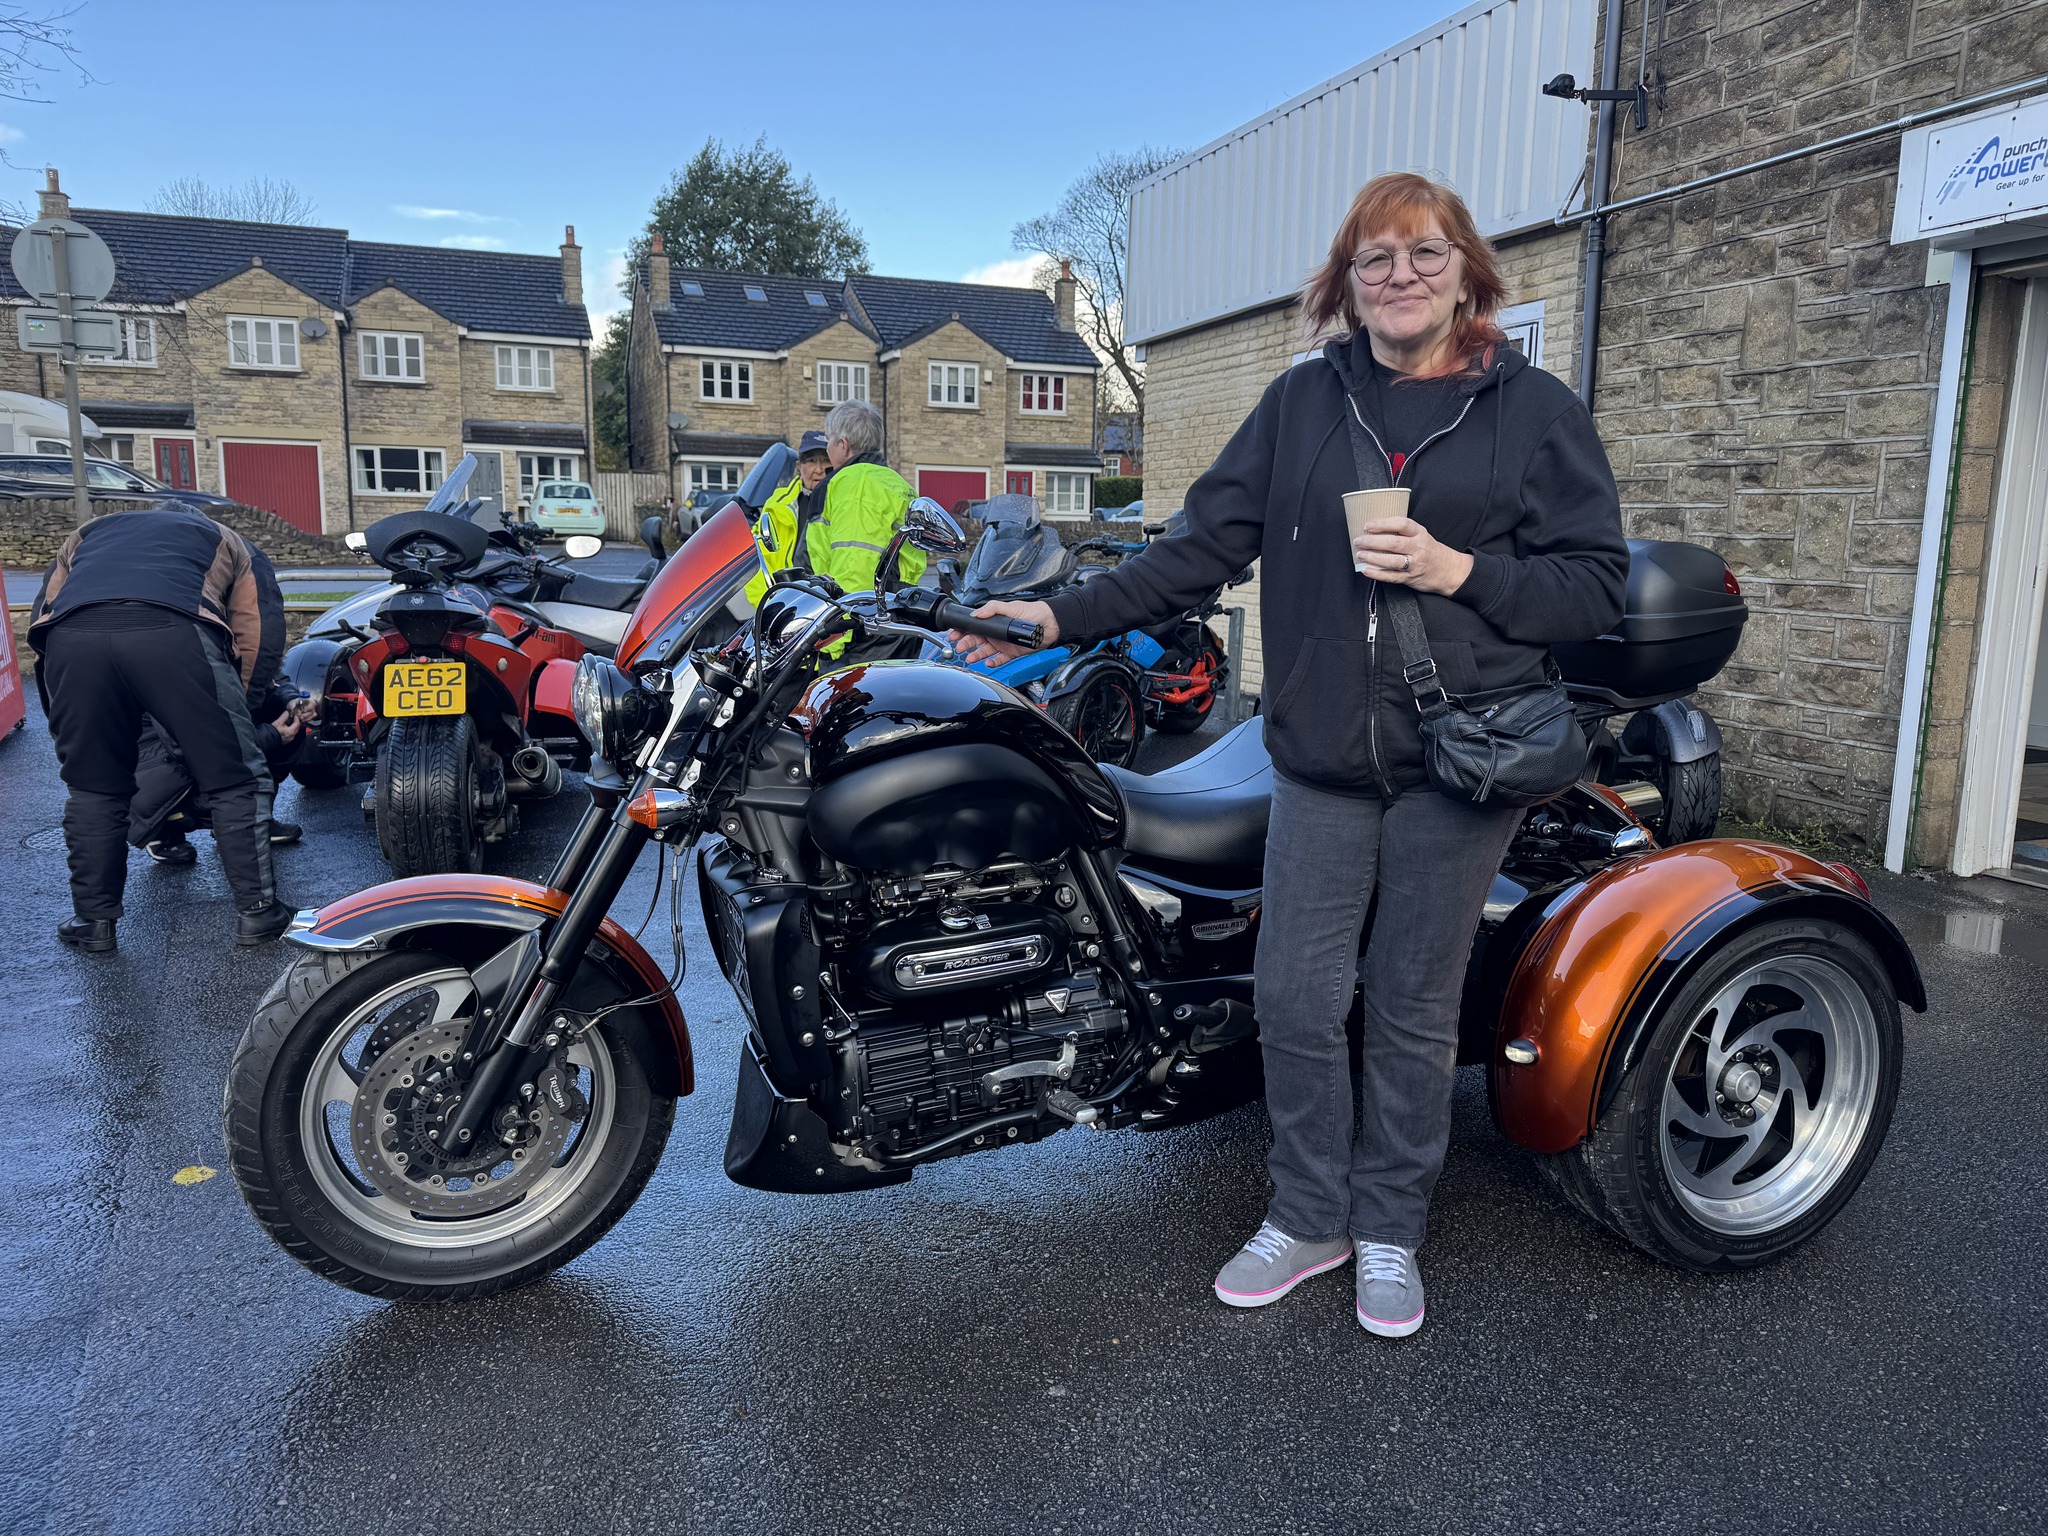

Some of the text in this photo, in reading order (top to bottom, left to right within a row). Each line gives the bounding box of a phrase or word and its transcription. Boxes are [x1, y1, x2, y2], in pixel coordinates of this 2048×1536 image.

[1899, 119, 1911, 127] GAS
[2002, 137, 2048, 161] punch
[1996, 174, 2046, 191] Gear up for
[389, 667, 463, 689] AE62
[397, 689, 453, 710] CEO
[1195, 923, 1230, 933] GRINNALL
[943, 952, 1010, 970] ROADSTER
[549, 1074, 566, 1109] TRIUMPH
